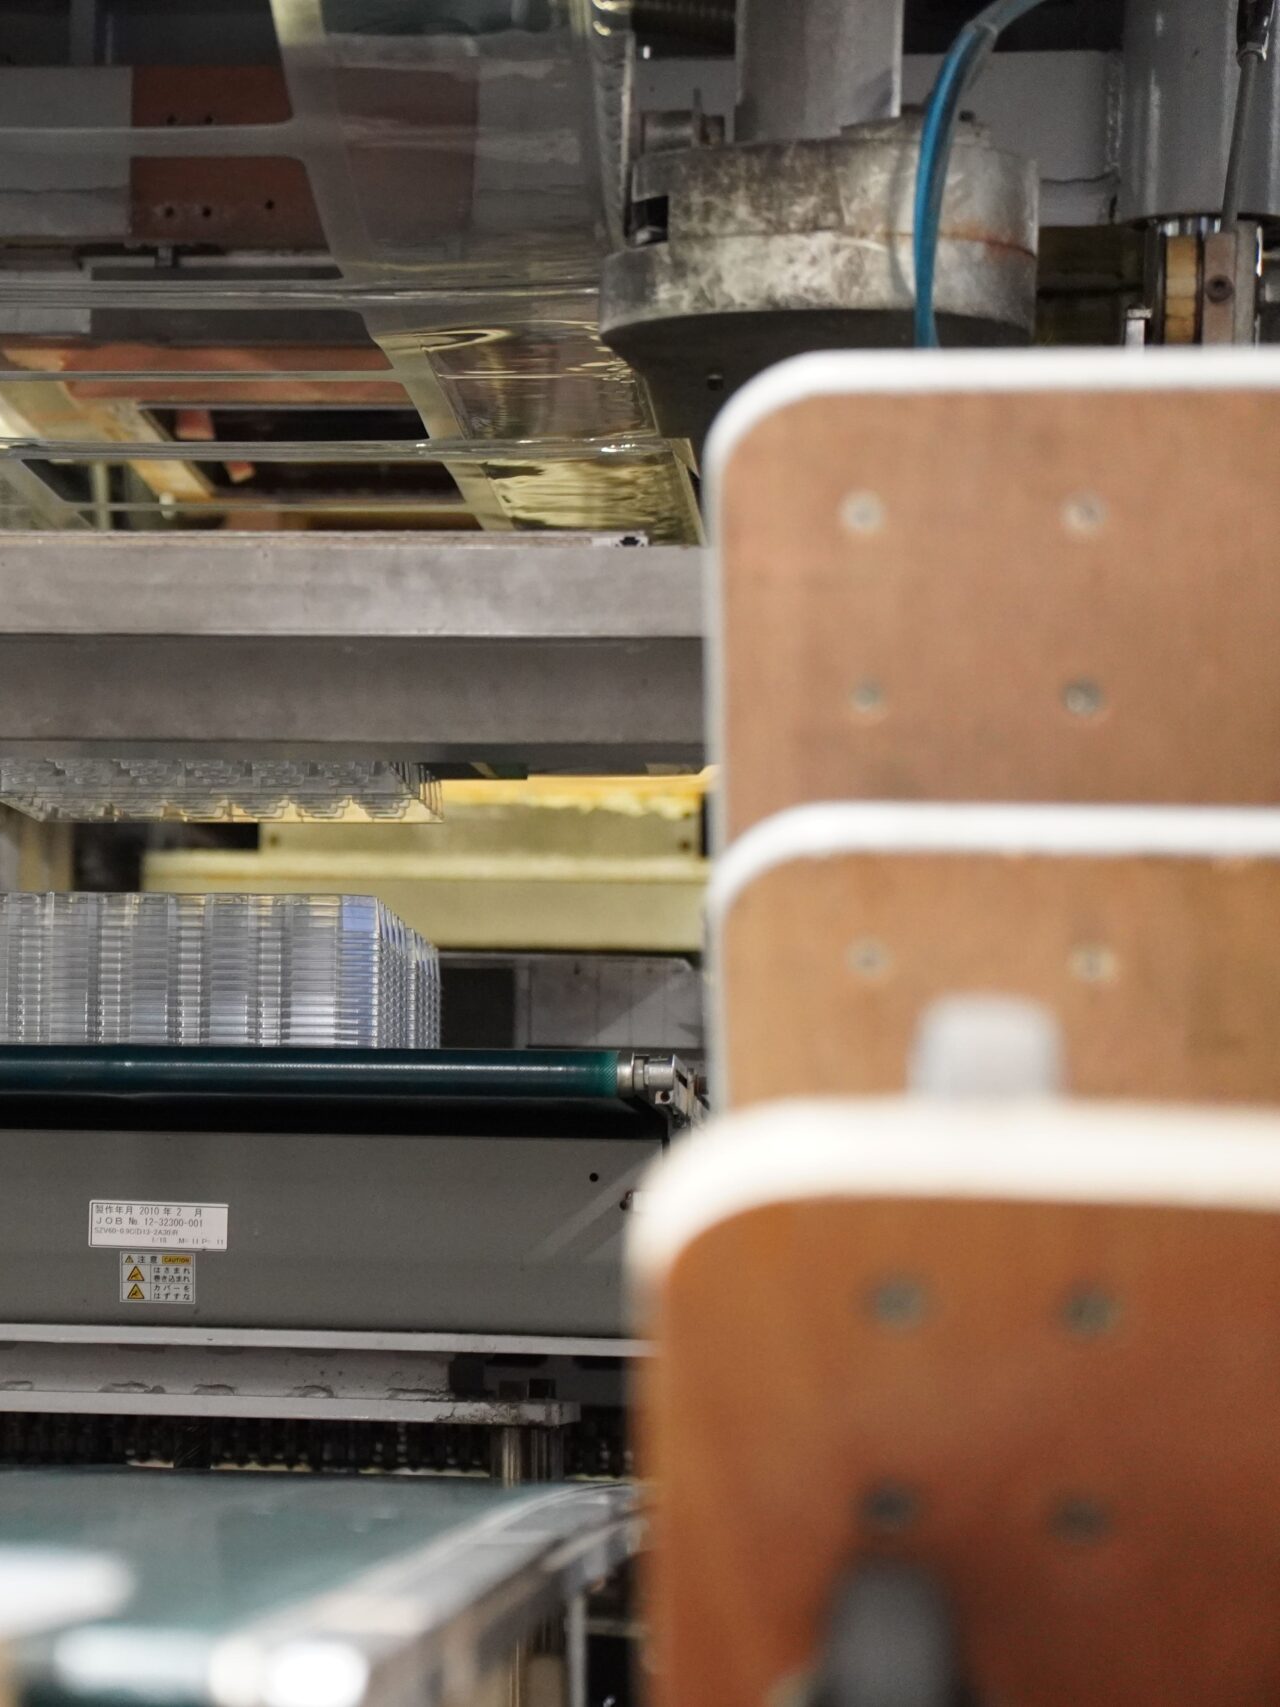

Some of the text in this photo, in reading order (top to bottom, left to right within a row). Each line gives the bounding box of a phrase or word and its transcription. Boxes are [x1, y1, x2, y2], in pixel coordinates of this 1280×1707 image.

[95, 1204, 202, 1217] 製作年月 2010 年 2 月
[95, 1216, 123, 1225] JOB
[144, 1217, 203, 1228] 12-32300-001
[137, 1255, 158, 1263] 注意
[153, 1267, 190, 1275] はさまれ
[153, 1275, 190, 1283] 巻き込まれ
[153, 1284, 190, 1293] カバーを
